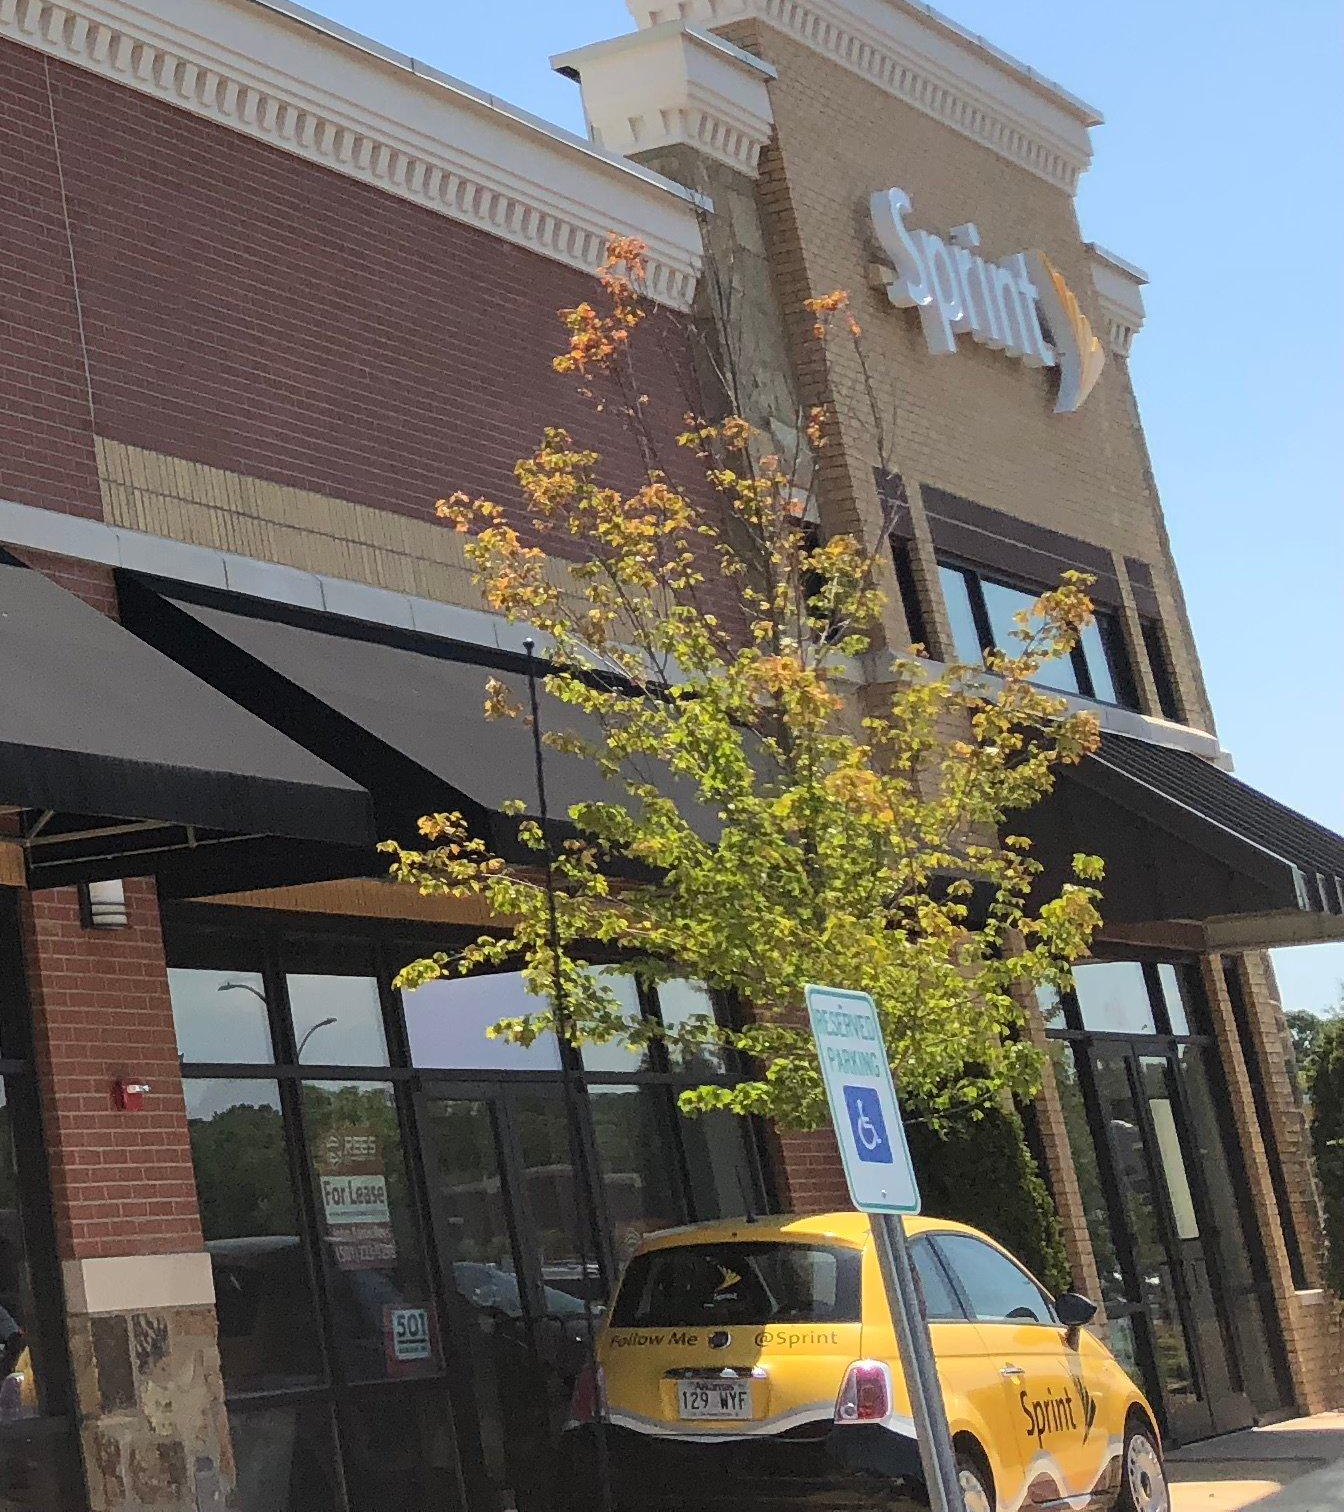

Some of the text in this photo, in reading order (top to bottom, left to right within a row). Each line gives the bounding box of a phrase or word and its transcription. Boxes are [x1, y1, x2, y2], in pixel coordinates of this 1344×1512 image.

[875, 187, 1056, 368] Sprint
[323, 1180, 385, 1207] For Lease
[668, 1331, 698, 1346] Me
[754, 1331, 838, 1349] @Sprint
[682, 1390, 709, 1410] 129
[1019, 1386, 1077, 1449] Sprint
